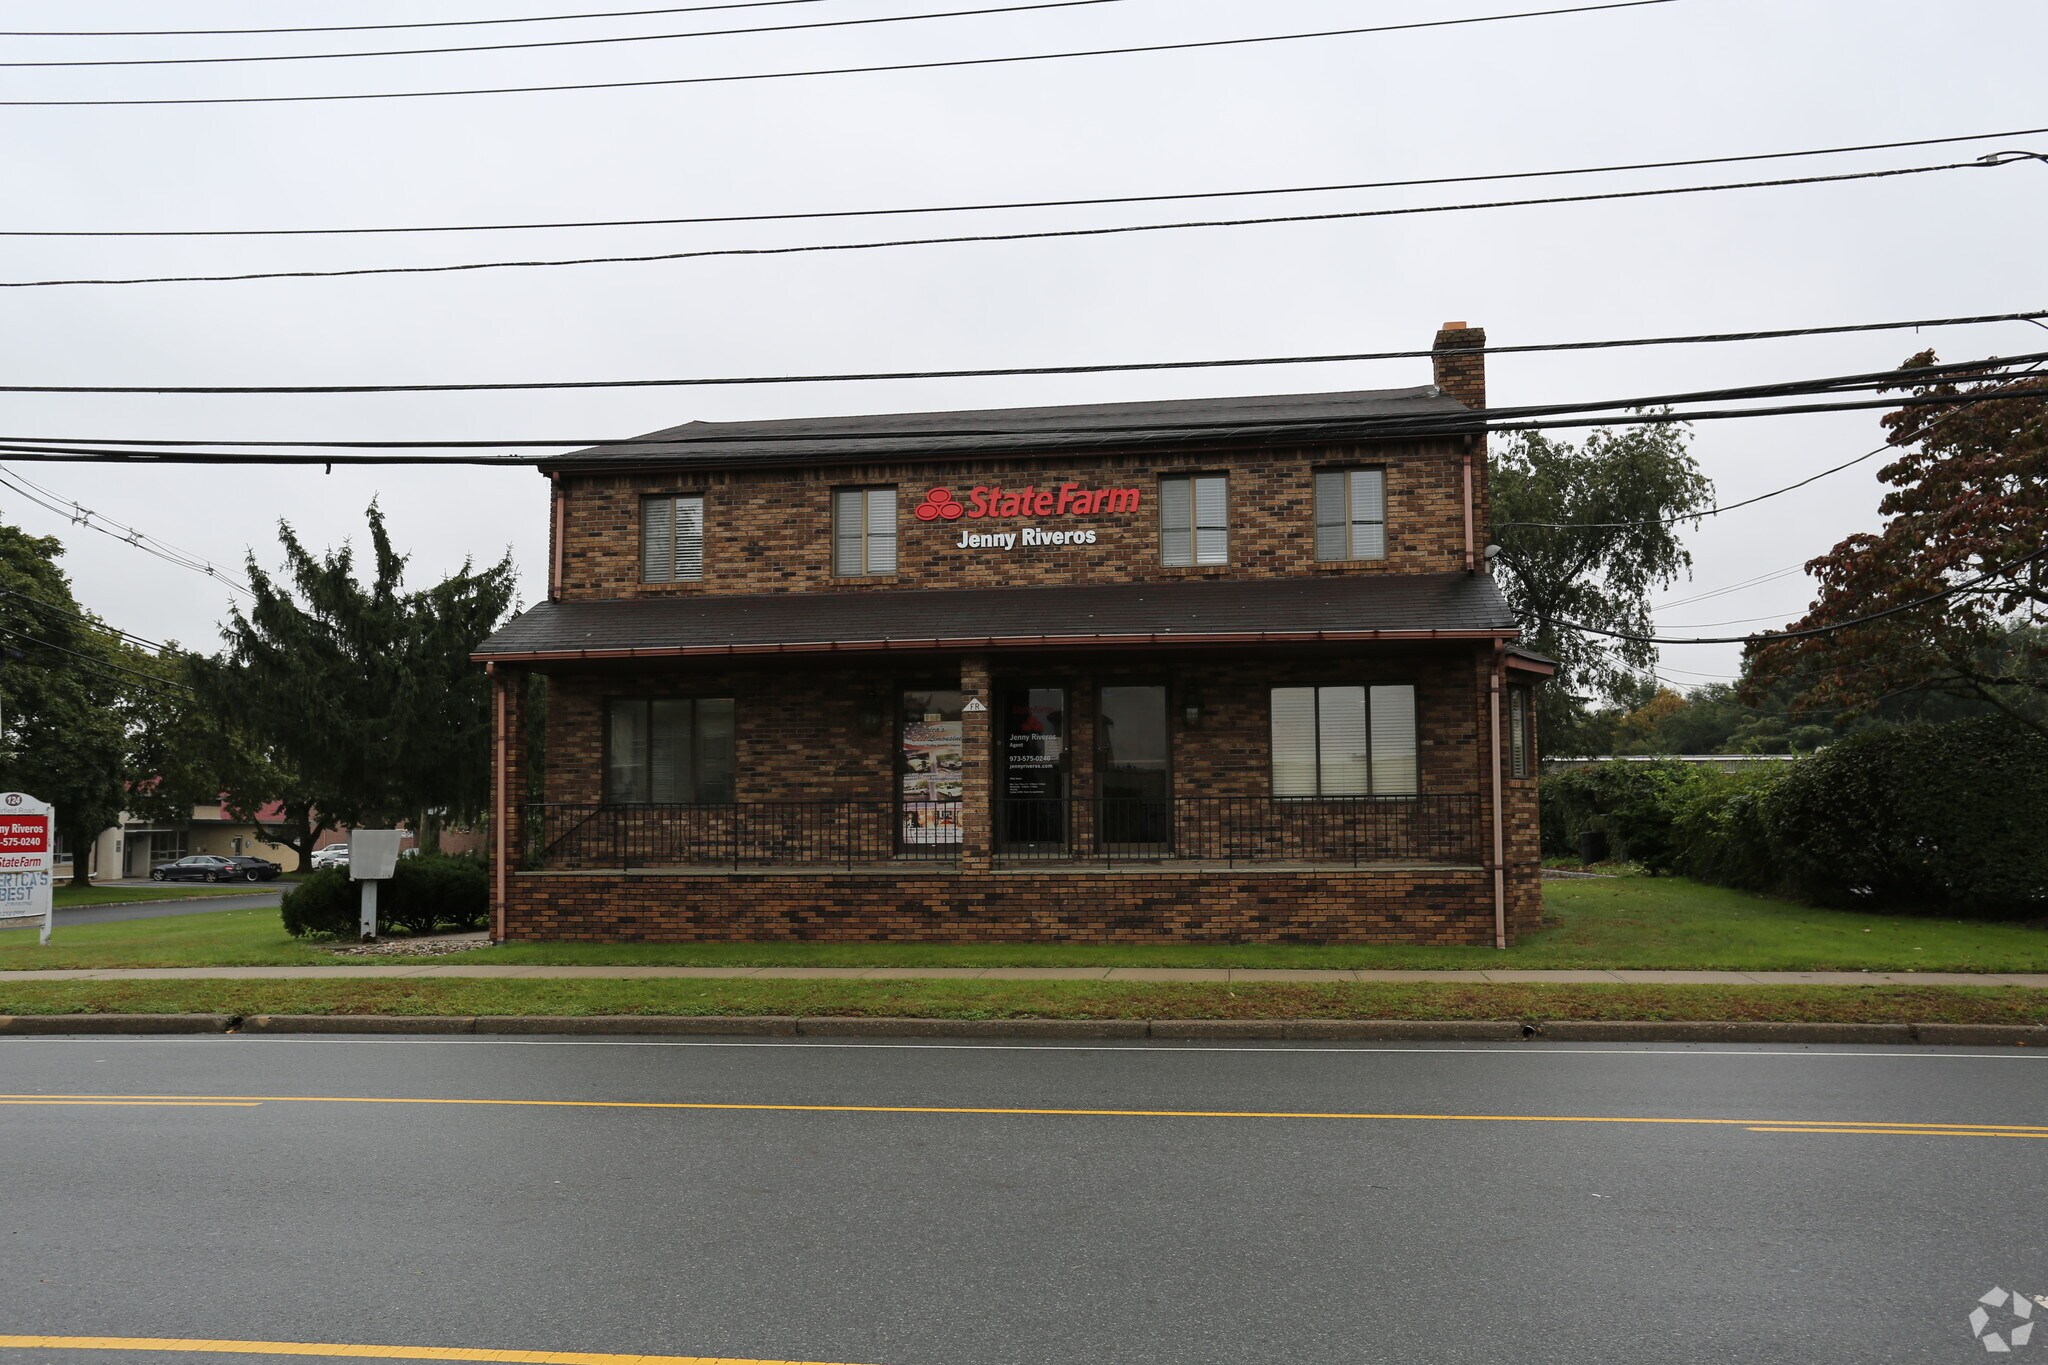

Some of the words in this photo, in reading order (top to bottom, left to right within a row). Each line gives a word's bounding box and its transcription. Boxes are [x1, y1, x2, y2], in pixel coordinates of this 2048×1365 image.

[967, 482, 1141, 518] StateFarm
[956, 530, 1017, 550] Jenny
[1022, 528, 1097, 546] Riveros
[970, 703, 980, 711] FR
[1010, 733, 1030, 742] Jenny
[7, 796, 21, 804] 124
[12, 824, 43, 833] Riveros
[0, 887, 33, 901] BEST
